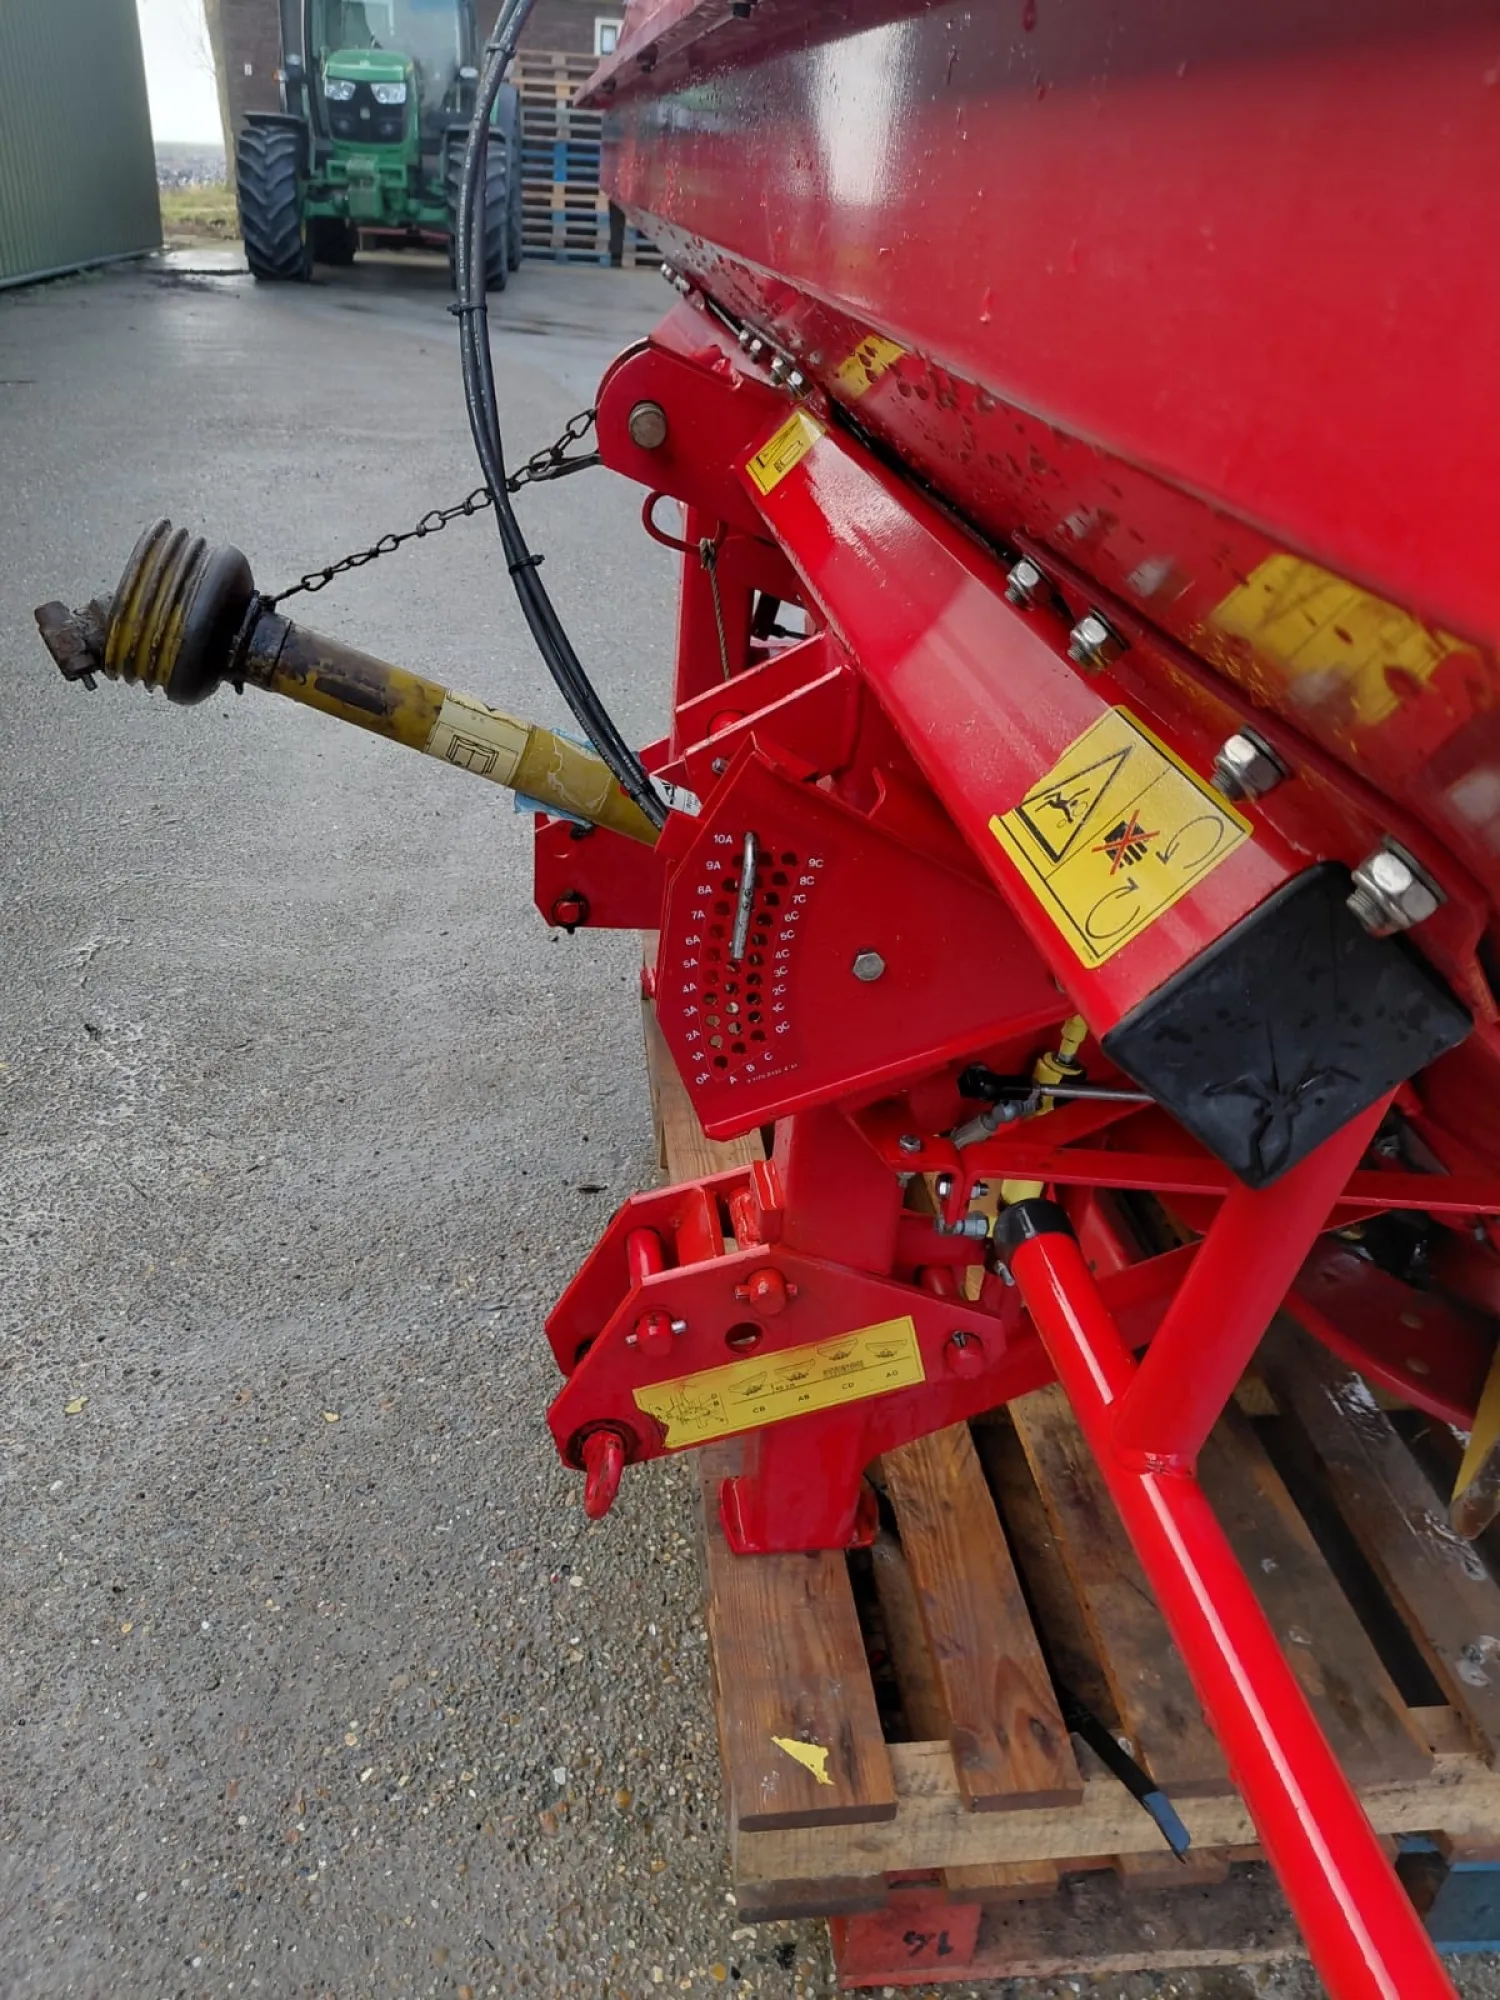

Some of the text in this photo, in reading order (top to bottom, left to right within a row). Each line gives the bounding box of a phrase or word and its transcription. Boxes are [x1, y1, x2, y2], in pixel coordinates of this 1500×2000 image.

[714, 832, 734, 844] 10A
[706, 860, 721, 871] 9A
[808, 858, 824, 869] 9C
[800, 875, 815, 886] 8C
[697, 884, 713, 895] 8A
[792, 894, 807, 905] 7C
[691, 910, 706, 921] 7A
[784, 911, 800, 923] 6C
[685, 935, 701, 946] 6A
[779, 930, 796, 941] 5C
[775, 949, 791, 960] 4C
[682, 957, 699, 969] 5A
[773, 965, 789, 978] 3C
[682, 982, 698, 994] 4A
[772, 983, 787, 995] 2C
[683, 1005, 699, 1017] 3A
[685, 1029, 701, 1042] 2A
[763, 1051, 774, 1061] C
[745, 1063, 756, 1073] B
[729, 1074, 740, 1085] A
